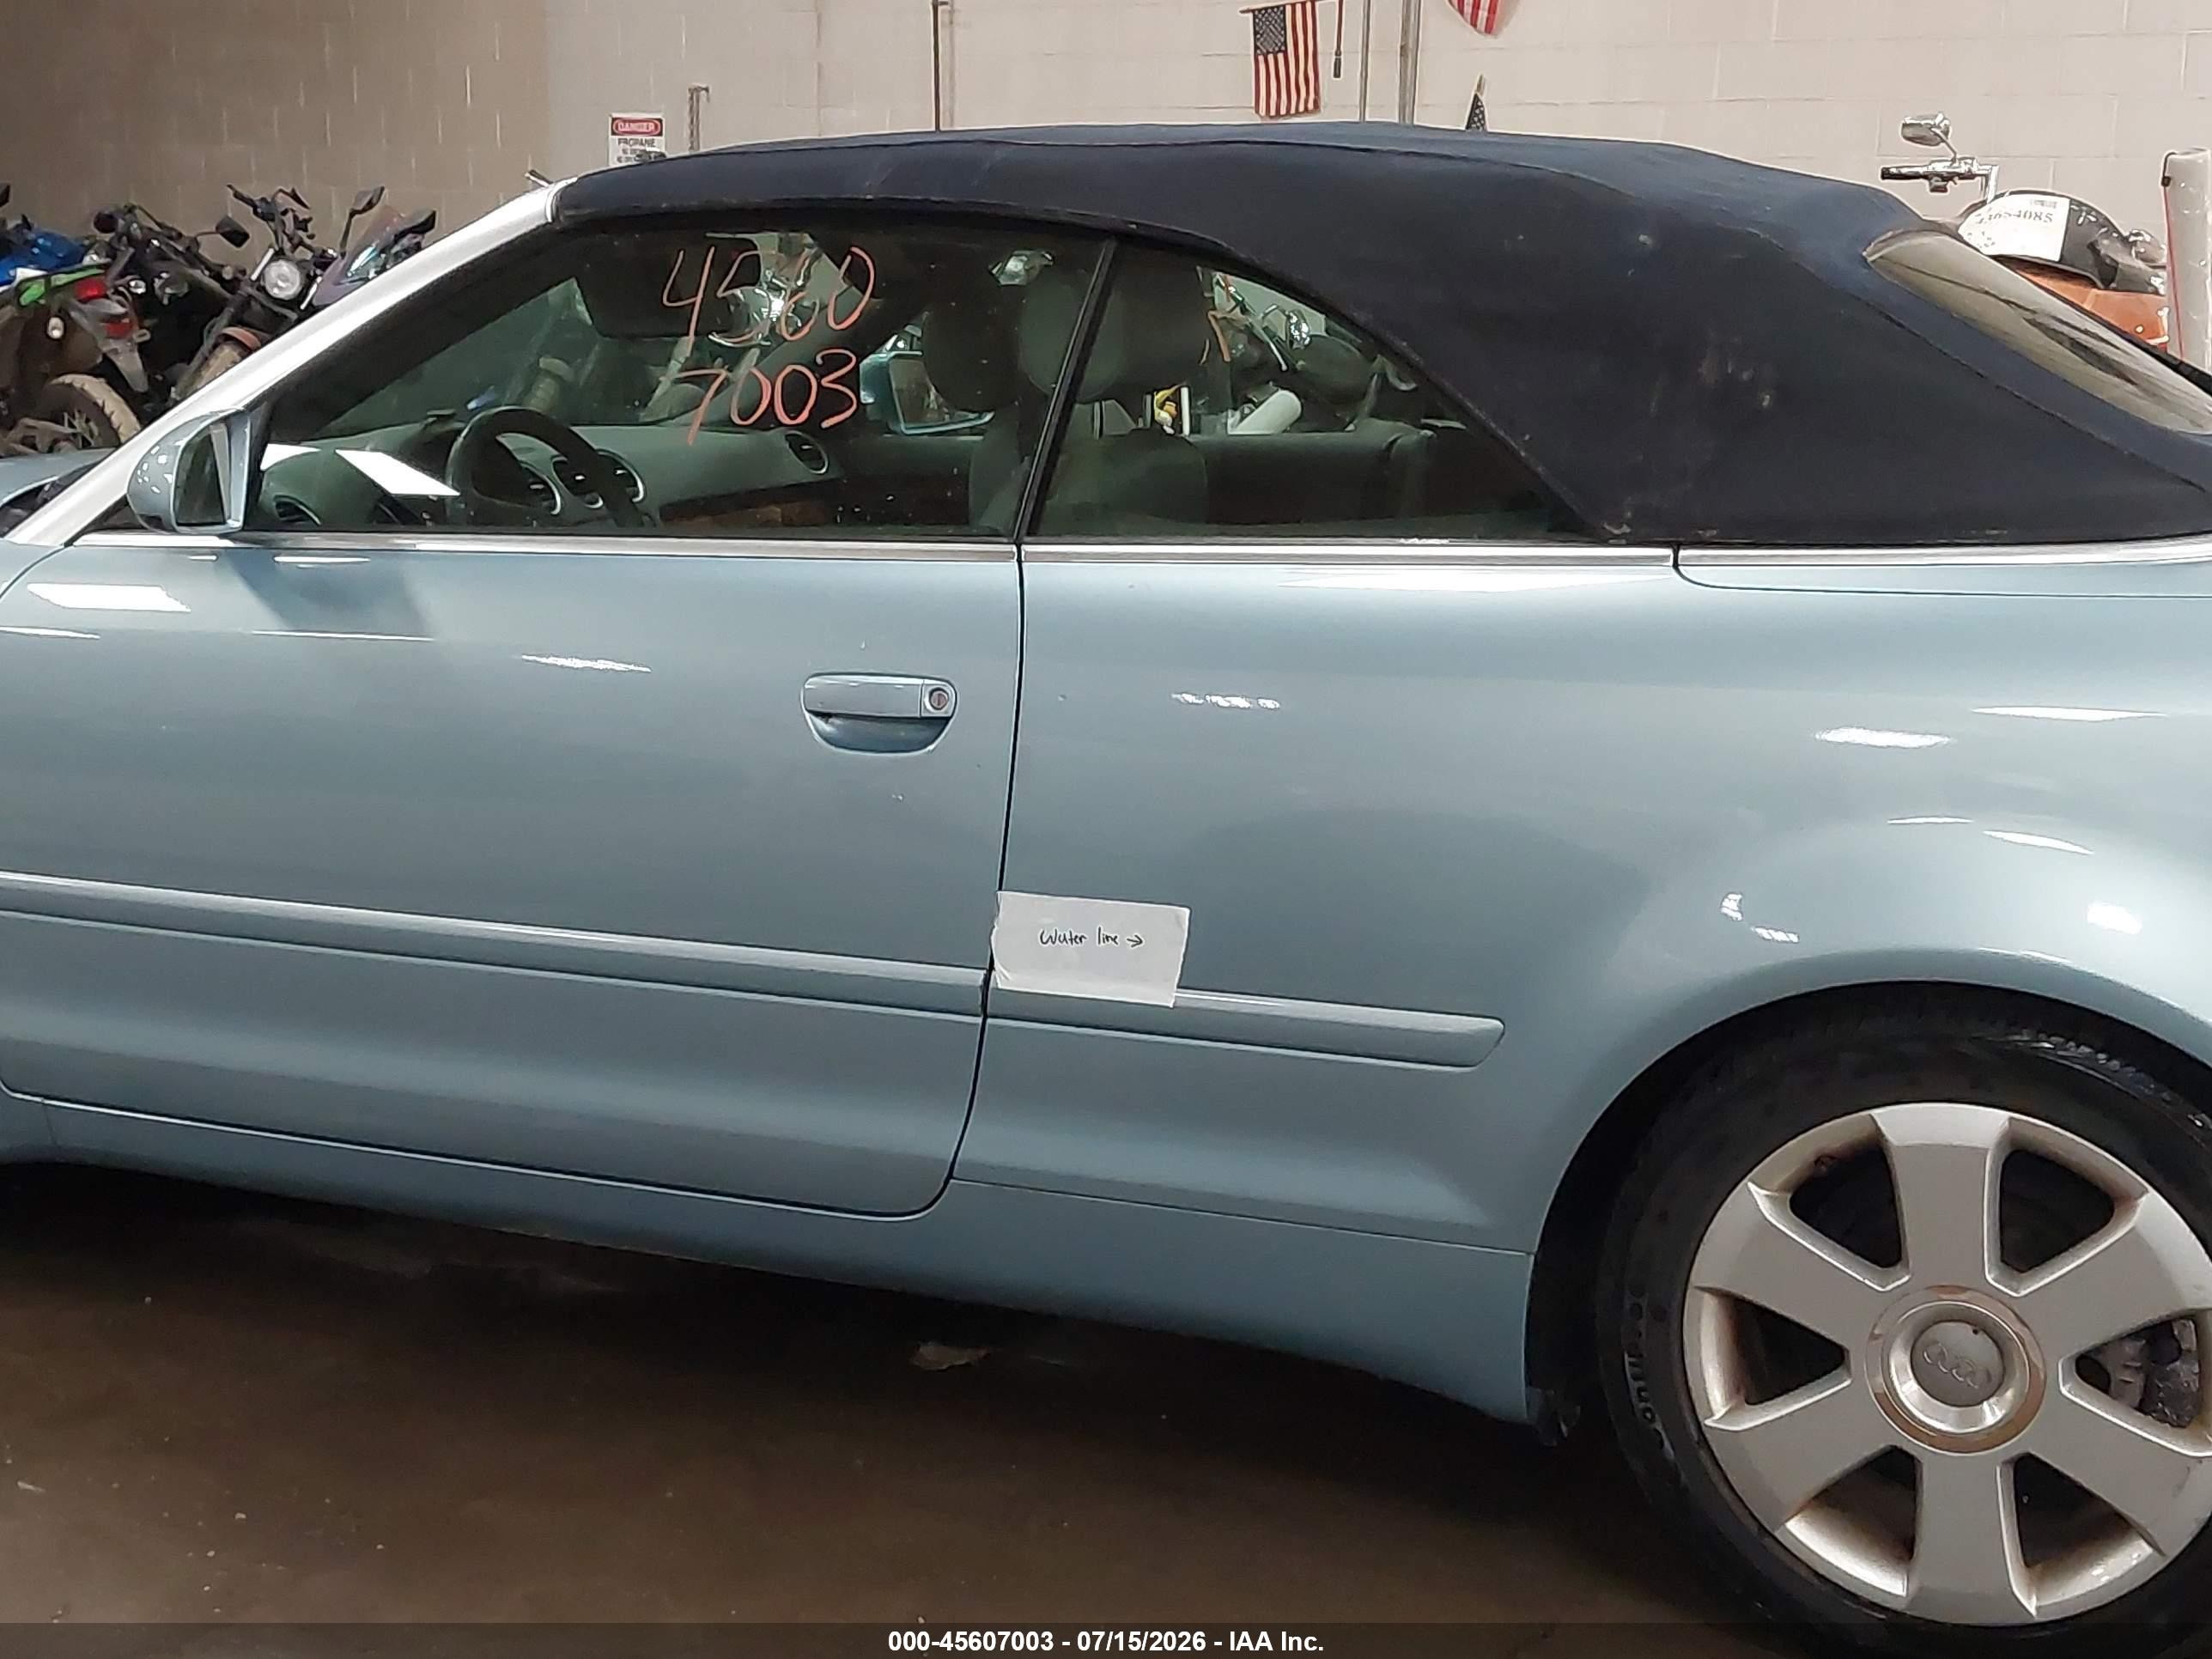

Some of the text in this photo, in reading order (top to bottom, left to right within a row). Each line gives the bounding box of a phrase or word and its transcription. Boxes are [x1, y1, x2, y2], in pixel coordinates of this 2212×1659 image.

[617, 138, 656, 147] PROPANE
[663, 246, 874, 356] 4560
[665, 348, 857, 445] 7003
[1097, 927, 1119, 945] line
